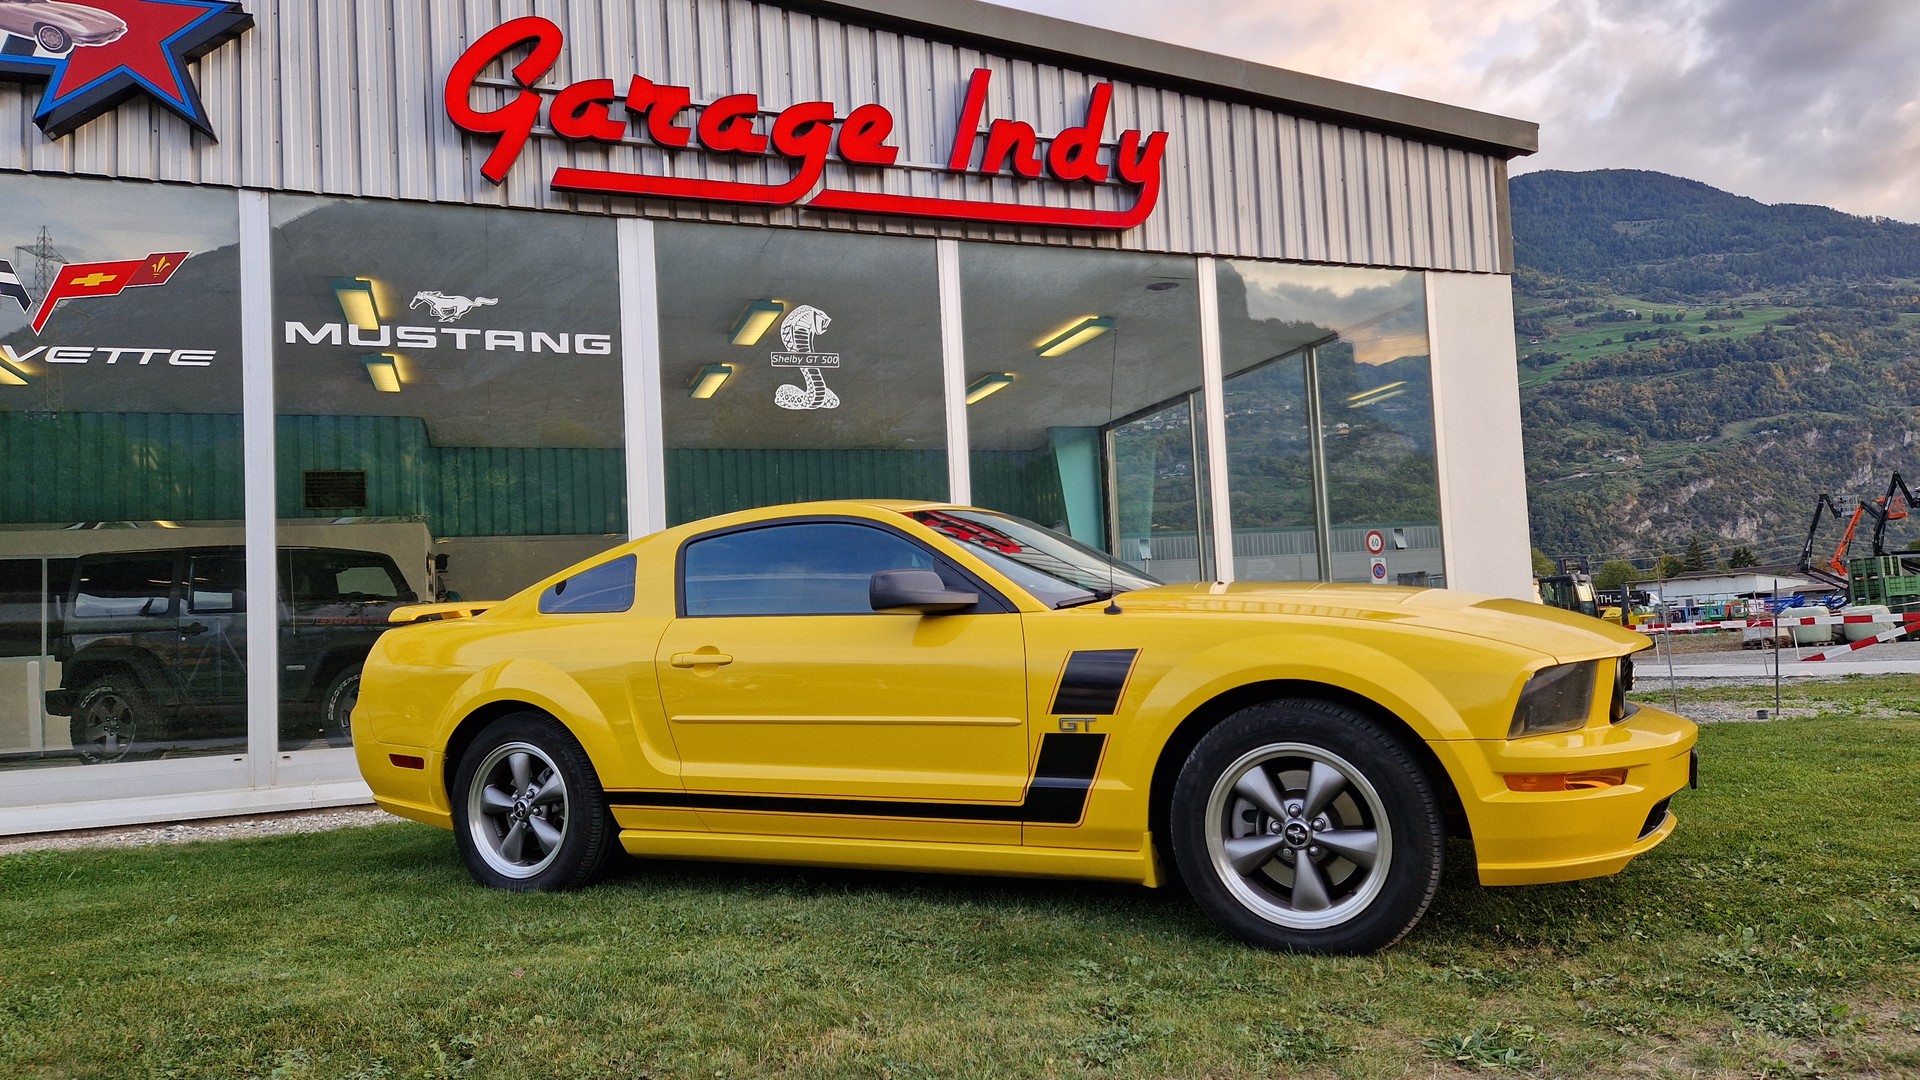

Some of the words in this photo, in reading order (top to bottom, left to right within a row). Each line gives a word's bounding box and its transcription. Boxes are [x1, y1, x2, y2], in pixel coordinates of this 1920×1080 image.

[444, 15, 899, 206] Garage
[803, 67, 1169, 230] Indy
[285, 321, 611, 355] MUSTANG
[772, 354, 803, 365] Shelby
[805, 355, 819, 364] GT
[821, 355, 838, 364] 500
[1059, 717, 1097, 732] GT
